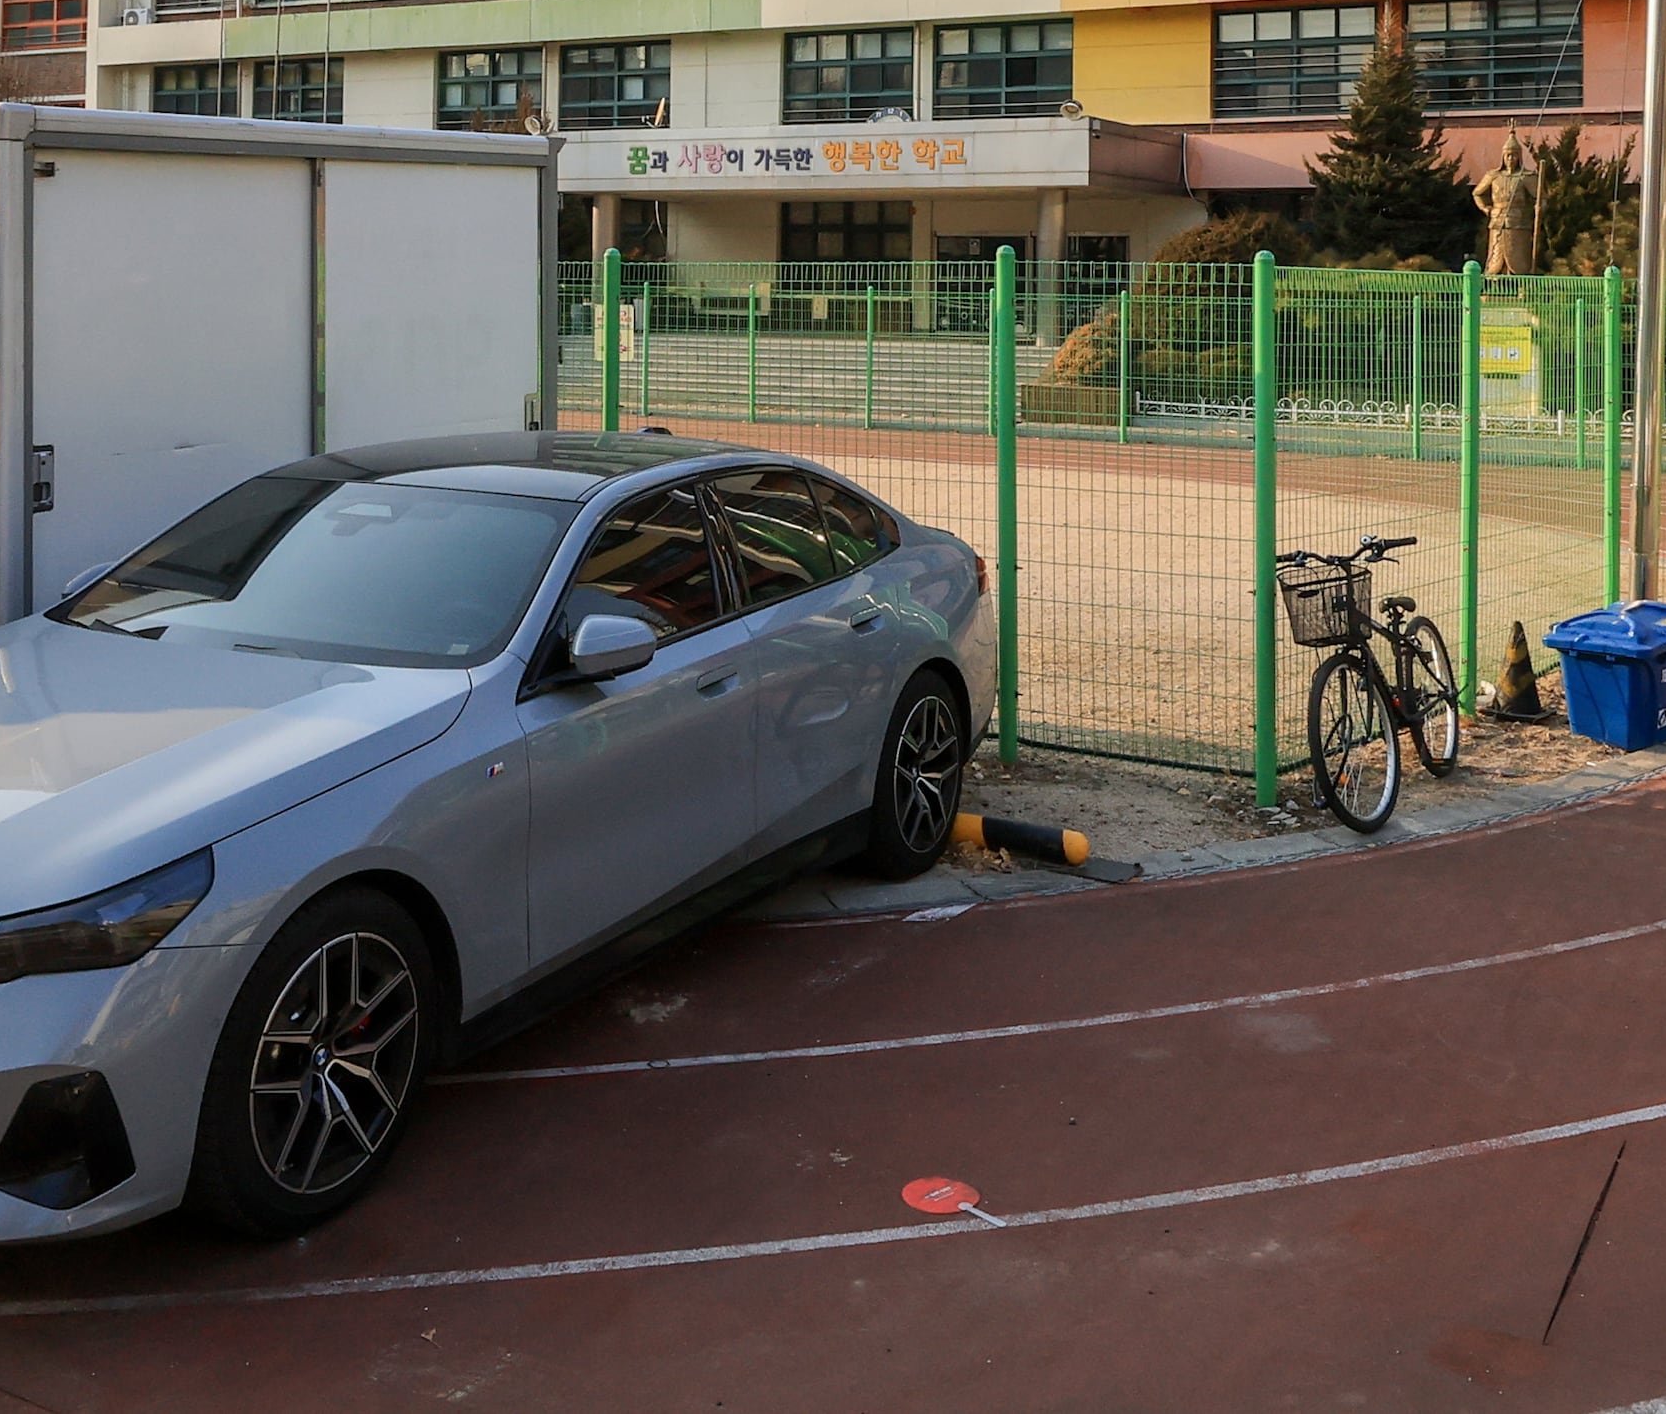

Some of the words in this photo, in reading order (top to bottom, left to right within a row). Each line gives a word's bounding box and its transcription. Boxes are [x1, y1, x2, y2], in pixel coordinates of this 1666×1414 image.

[627, 146, 670, 175] 꿈과
[677, 143, 744, 174] 사랑이
[754, 147, 814, 171] 가득한
[821, 138, 903, 173] 행복한
[911, 138, 968, 170] 학교
